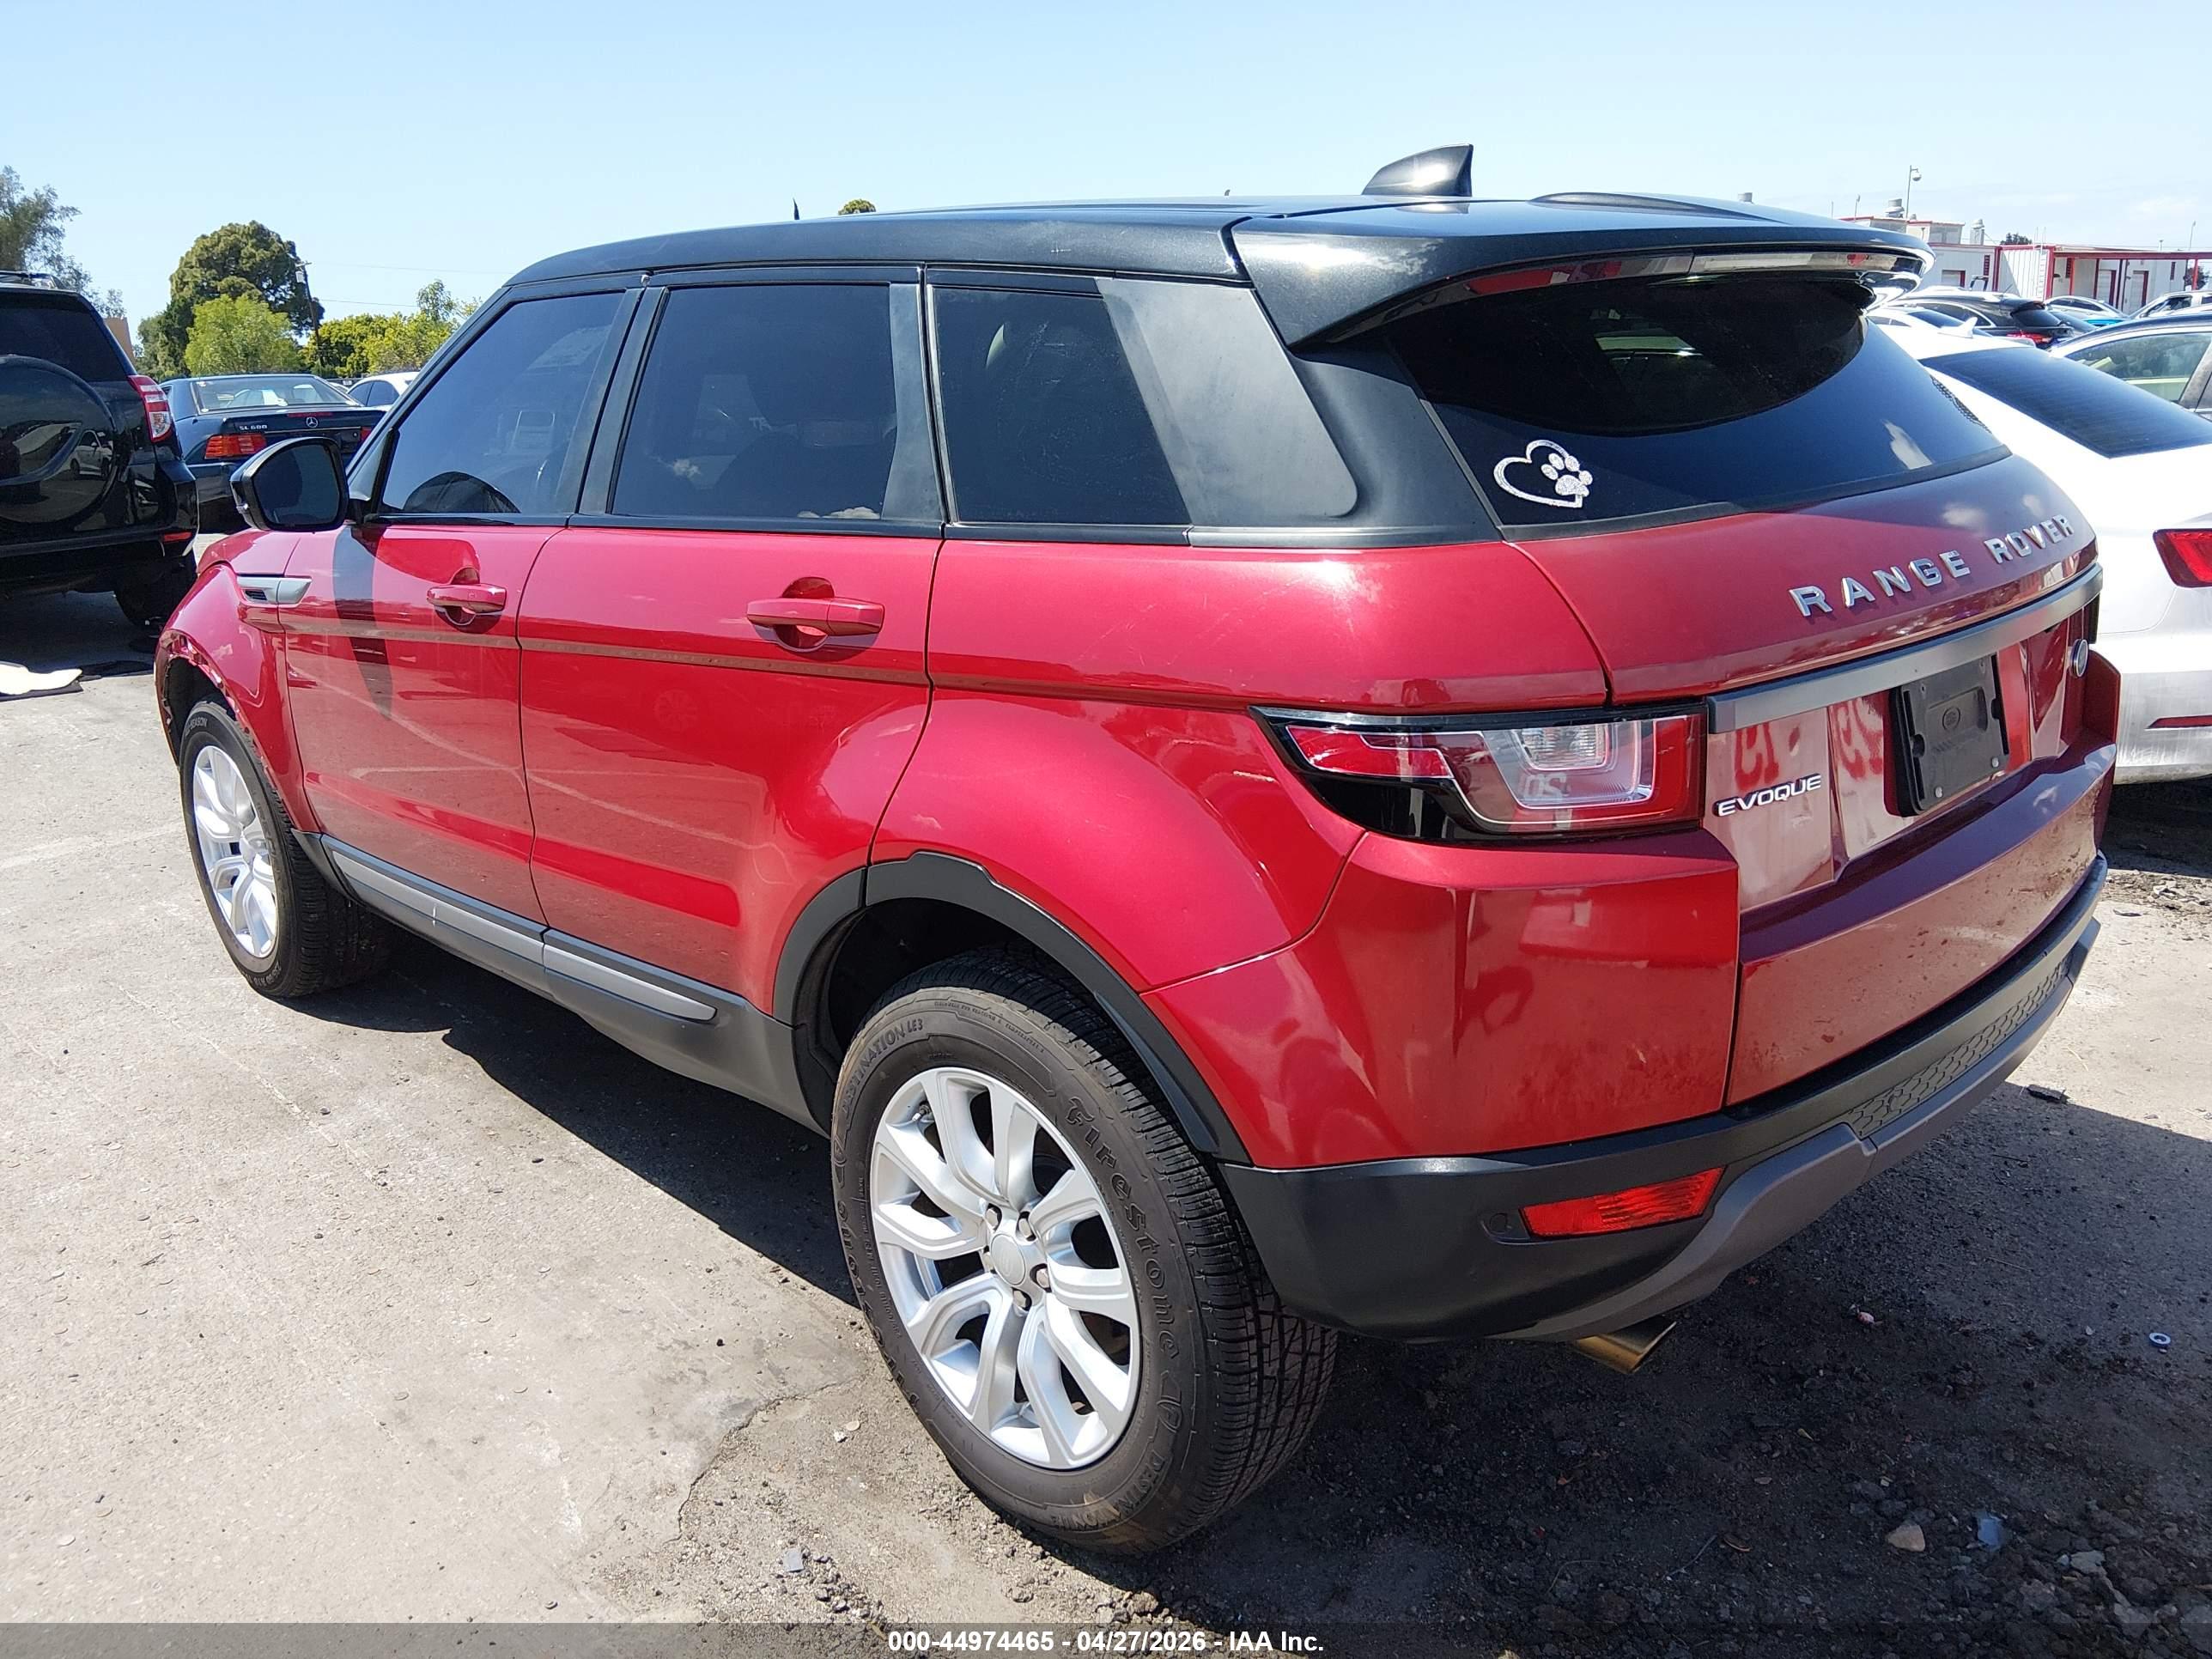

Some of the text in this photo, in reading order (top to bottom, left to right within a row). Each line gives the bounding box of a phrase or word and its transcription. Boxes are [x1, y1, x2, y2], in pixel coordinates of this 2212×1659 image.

[1789, 514, 2075, 617] RANGE ROVER
[1717, 774, 1821, 816] EVOQUE
